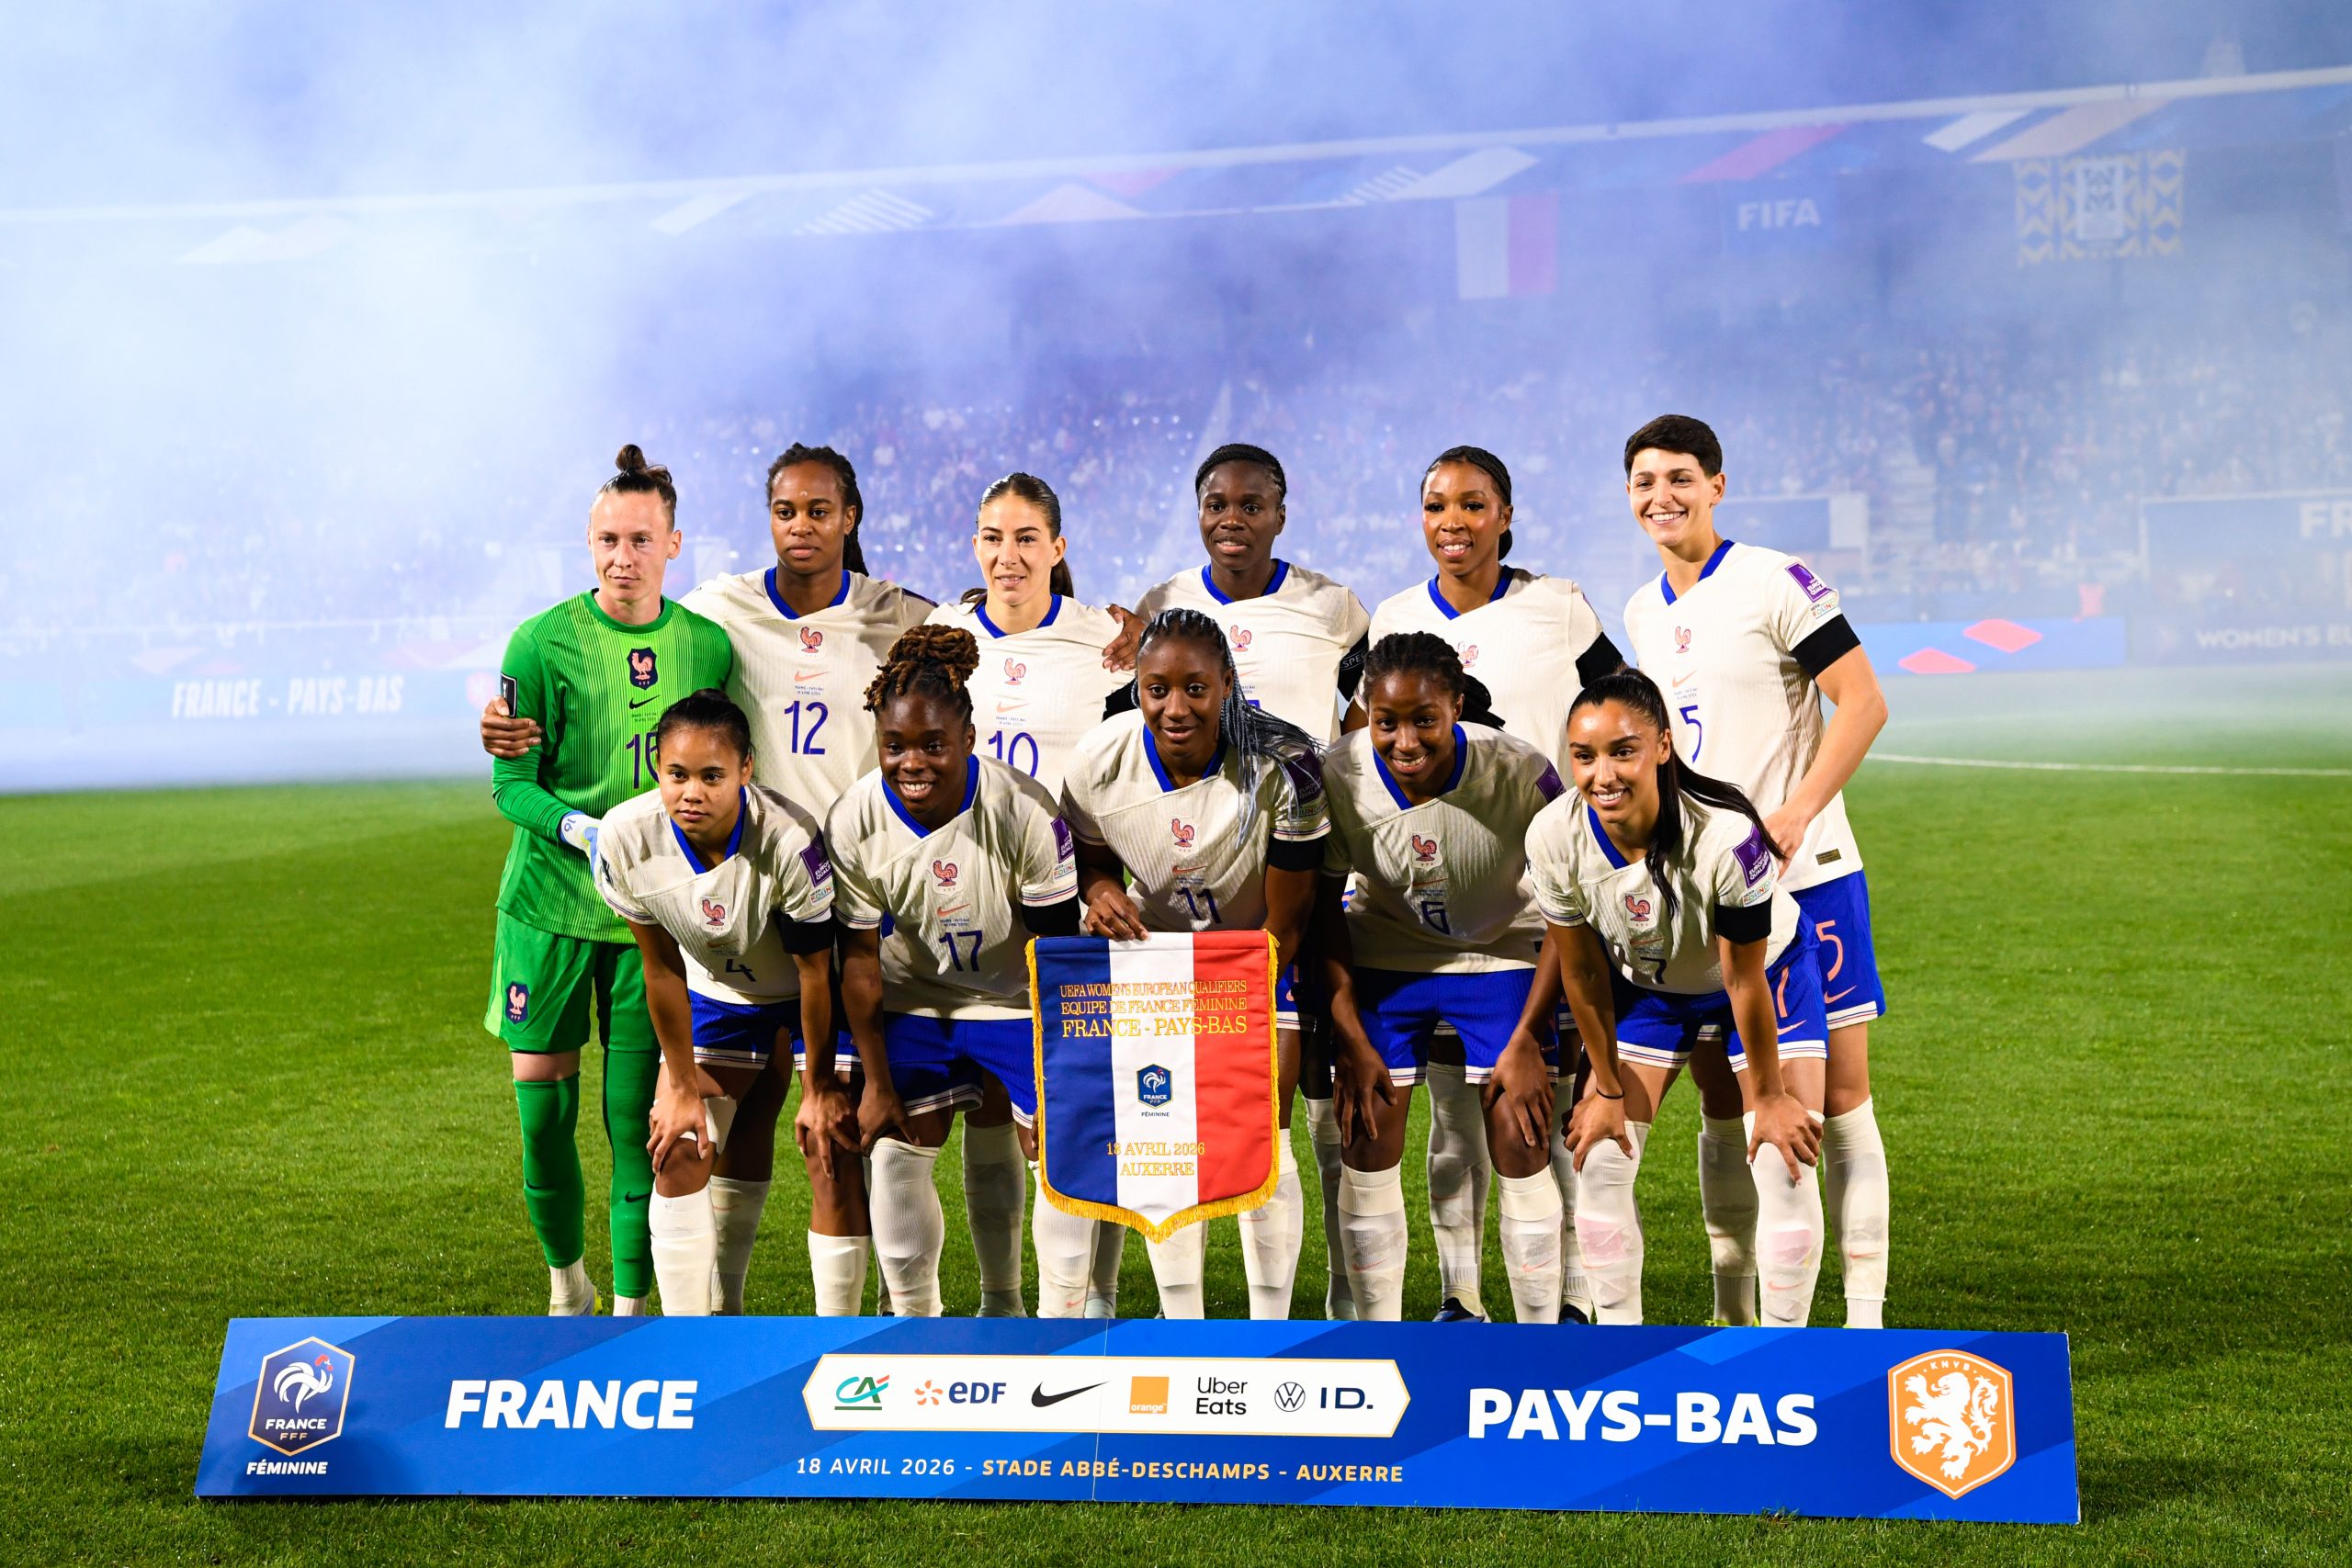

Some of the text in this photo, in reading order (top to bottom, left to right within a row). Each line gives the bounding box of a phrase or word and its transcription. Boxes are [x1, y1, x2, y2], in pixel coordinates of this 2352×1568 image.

[1738, 199, 1821, 231] FIFA
[2196, 626, 2320, 649] WOMEN'S
[172, 678, 263, 718] FRANCE
[287, 674, 405, 716] PAYS-BAS
[784, 700, 829, 755] 12
[1679, 705, 1702, 764] 5
[988, 730, 1038, 777] 10
[1177, 886, 1222, 924] 11
[938, 930, 982, 972] 17
[1815, 919, 1843, 982] 5
[725, 958, 756, 983] 4
[1640, 956, 1667, 985] 7
[1059, 980, 1247, 998] UEFA WOMEN'S EUROPEAN QUALIFIERS
[1060, 998, 1248, 1016] EQUIPE DE FRANCE FEMININE
[1061, 1019, 1141, 1038] FRANCE
[1154, 1015, 1248, 1036] PAYS-BAS
[1106, 1142, 1205, 1156] 18 AVRIL 2026
[1120, 1161, 1195, 1176] AUXERRE
[1929, 1360, 1971, 1371] KNVB
[1197, 1376, 1248, 1394] Uber
[444, 1380, 698, 1429] FRANCE
[1131, 1404, 1163, 1413] orange
[1195, 1397, 1247, 1415] Eats
[1320, 1387, 1374, 1410] ID.
[265, 1418, 327, 1430] FRANCE
[1468, 1387, 1817, 1447] PAYS-BAS
[279, 1432, 308, 1440] FFF
[246, 1459, 328, 1475] FÉMININE
[797, 1458, 821, 1474] 18
[830, 1458, 891, 1475] AVRIL
[901, 1459, 955, 1475] 2026
[982, 1460, 1052, 1476] STADE
[1060, 1458, 1270, 1480] ABBÉ-DESCHAMPS
[1296, 1464, 1403, 1482] AUXERRE
